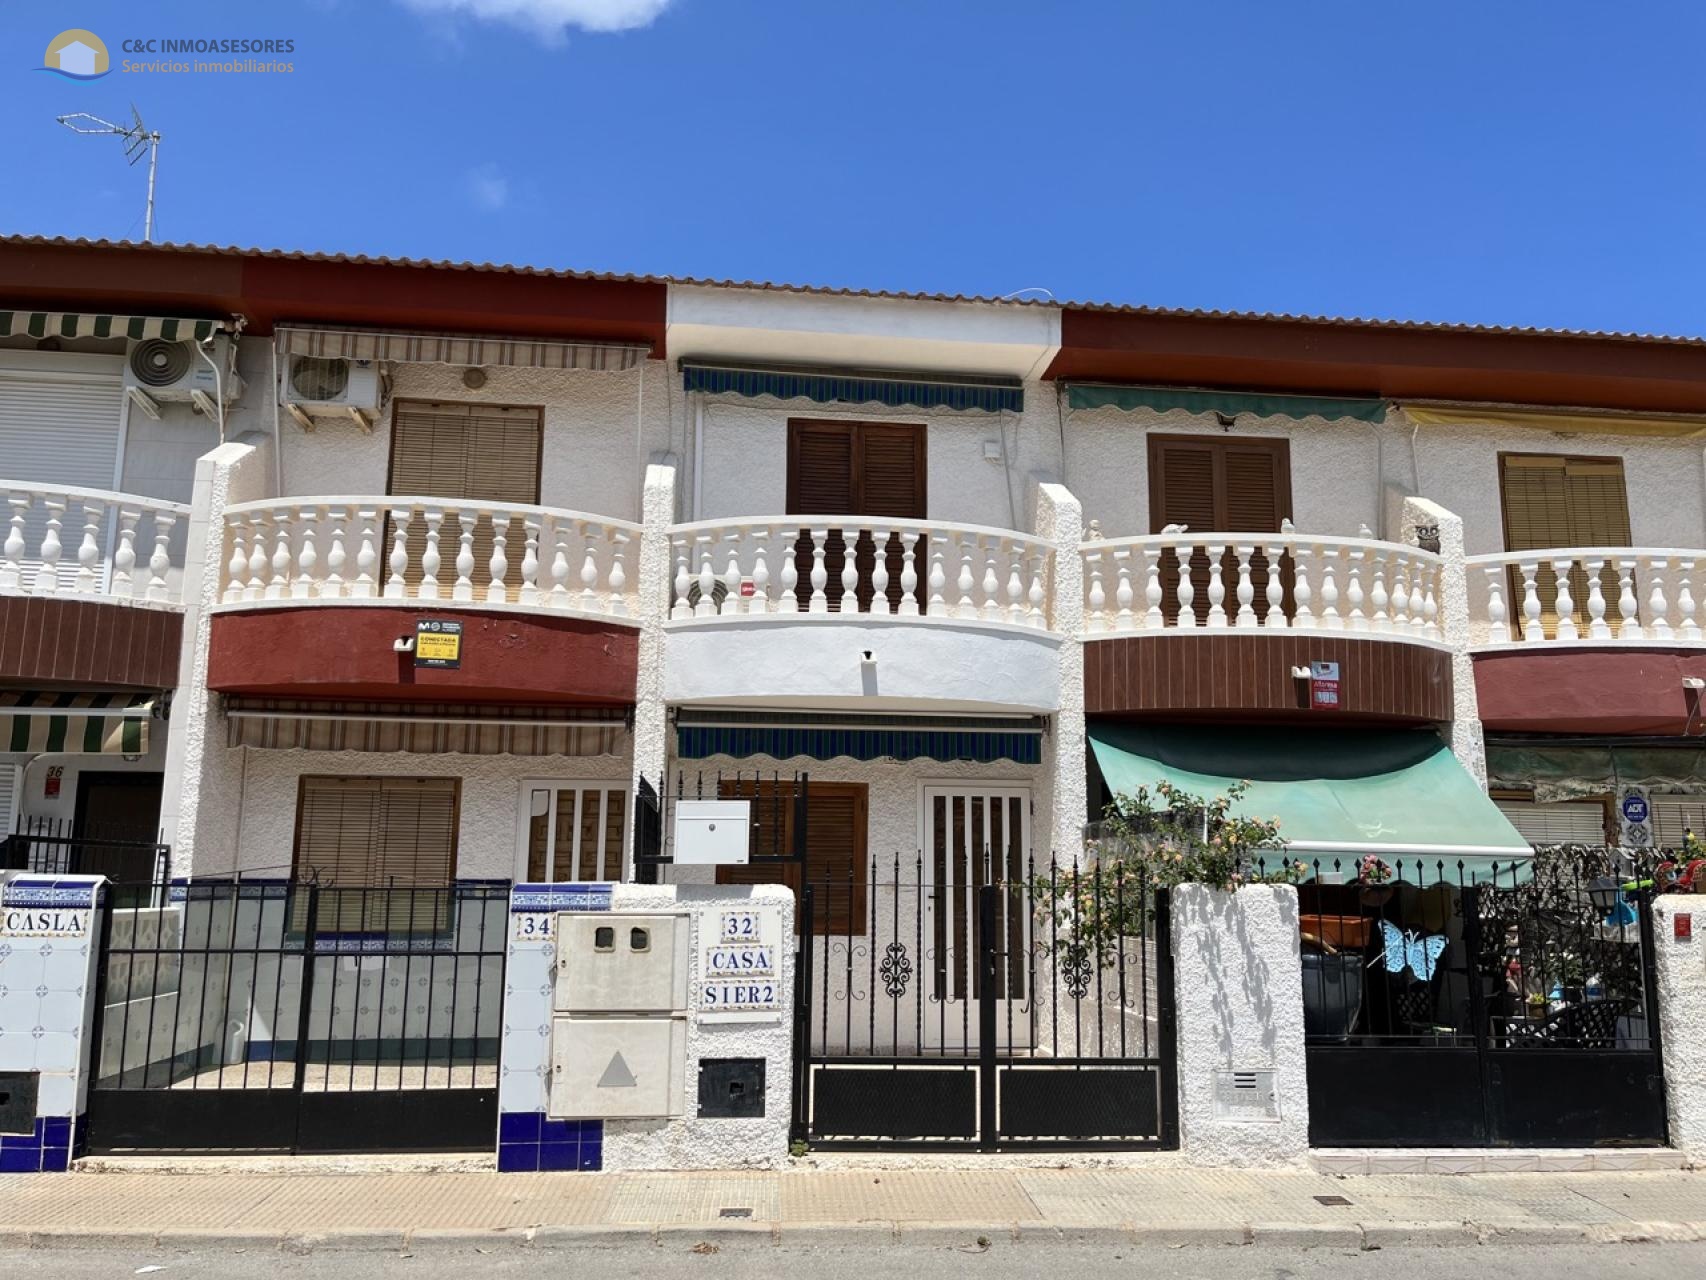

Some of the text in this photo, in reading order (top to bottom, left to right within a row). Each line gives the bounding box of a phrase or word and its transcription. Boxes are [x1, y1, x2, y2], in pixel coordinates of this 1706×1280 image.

[47, 766, 64, 777] 36
[7, 912, 81, 931] CASLA
[524, 918, 550, 934] 34
[728, 918, 753, 934] 32
[712, 952, 768, 969] CASA
[705, 986, 773, 1004] SIER2
